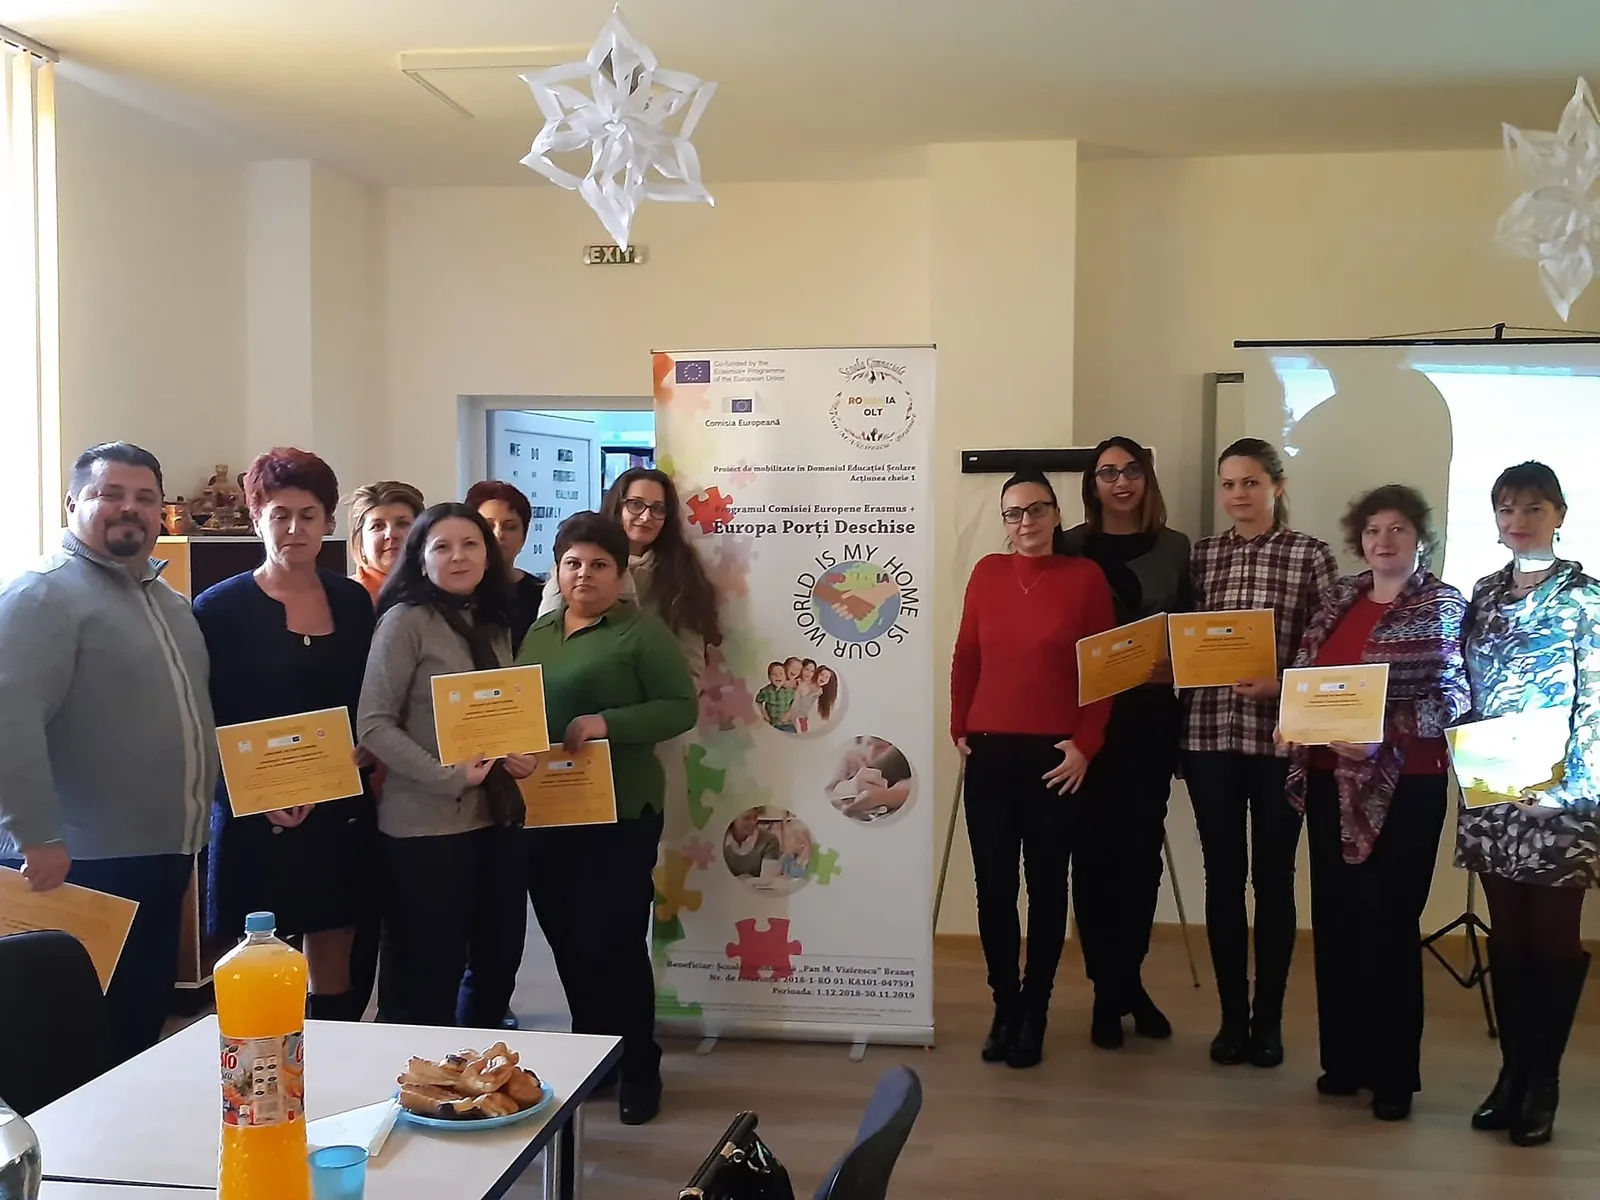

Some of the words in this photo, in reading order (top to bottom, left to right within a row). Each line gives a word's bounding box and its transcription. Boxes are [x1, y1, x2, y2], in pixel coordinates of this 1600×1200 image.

[590, 246, 634, 262] EXIT
[863, 408, 883, 417] OLT
[705, 419, 736, 427] Comisia
[713, 465, 741, 473] Proiect
[742, 464, 753, 473] de
[753, 464, 796, 473] mobilitate
[807, 464, 846, 472] Domeniul
[768, 504, 812, 513] Comisiei
[813, 504, 862, 515] Europene
[864, 504, 907, 513] Erasmus
[714, 520, 777, 539] Europa
[834, 519, 916, 534] Deschise
[814, 550, 836, 571] IS
[844, 543, 879, 562] MY
[882, 555, 920, 618] HOME
[793, 572, 827, 648] WORLD
[887, 623, 910, 645] IS
[833, 640, 881, 660] OUR
